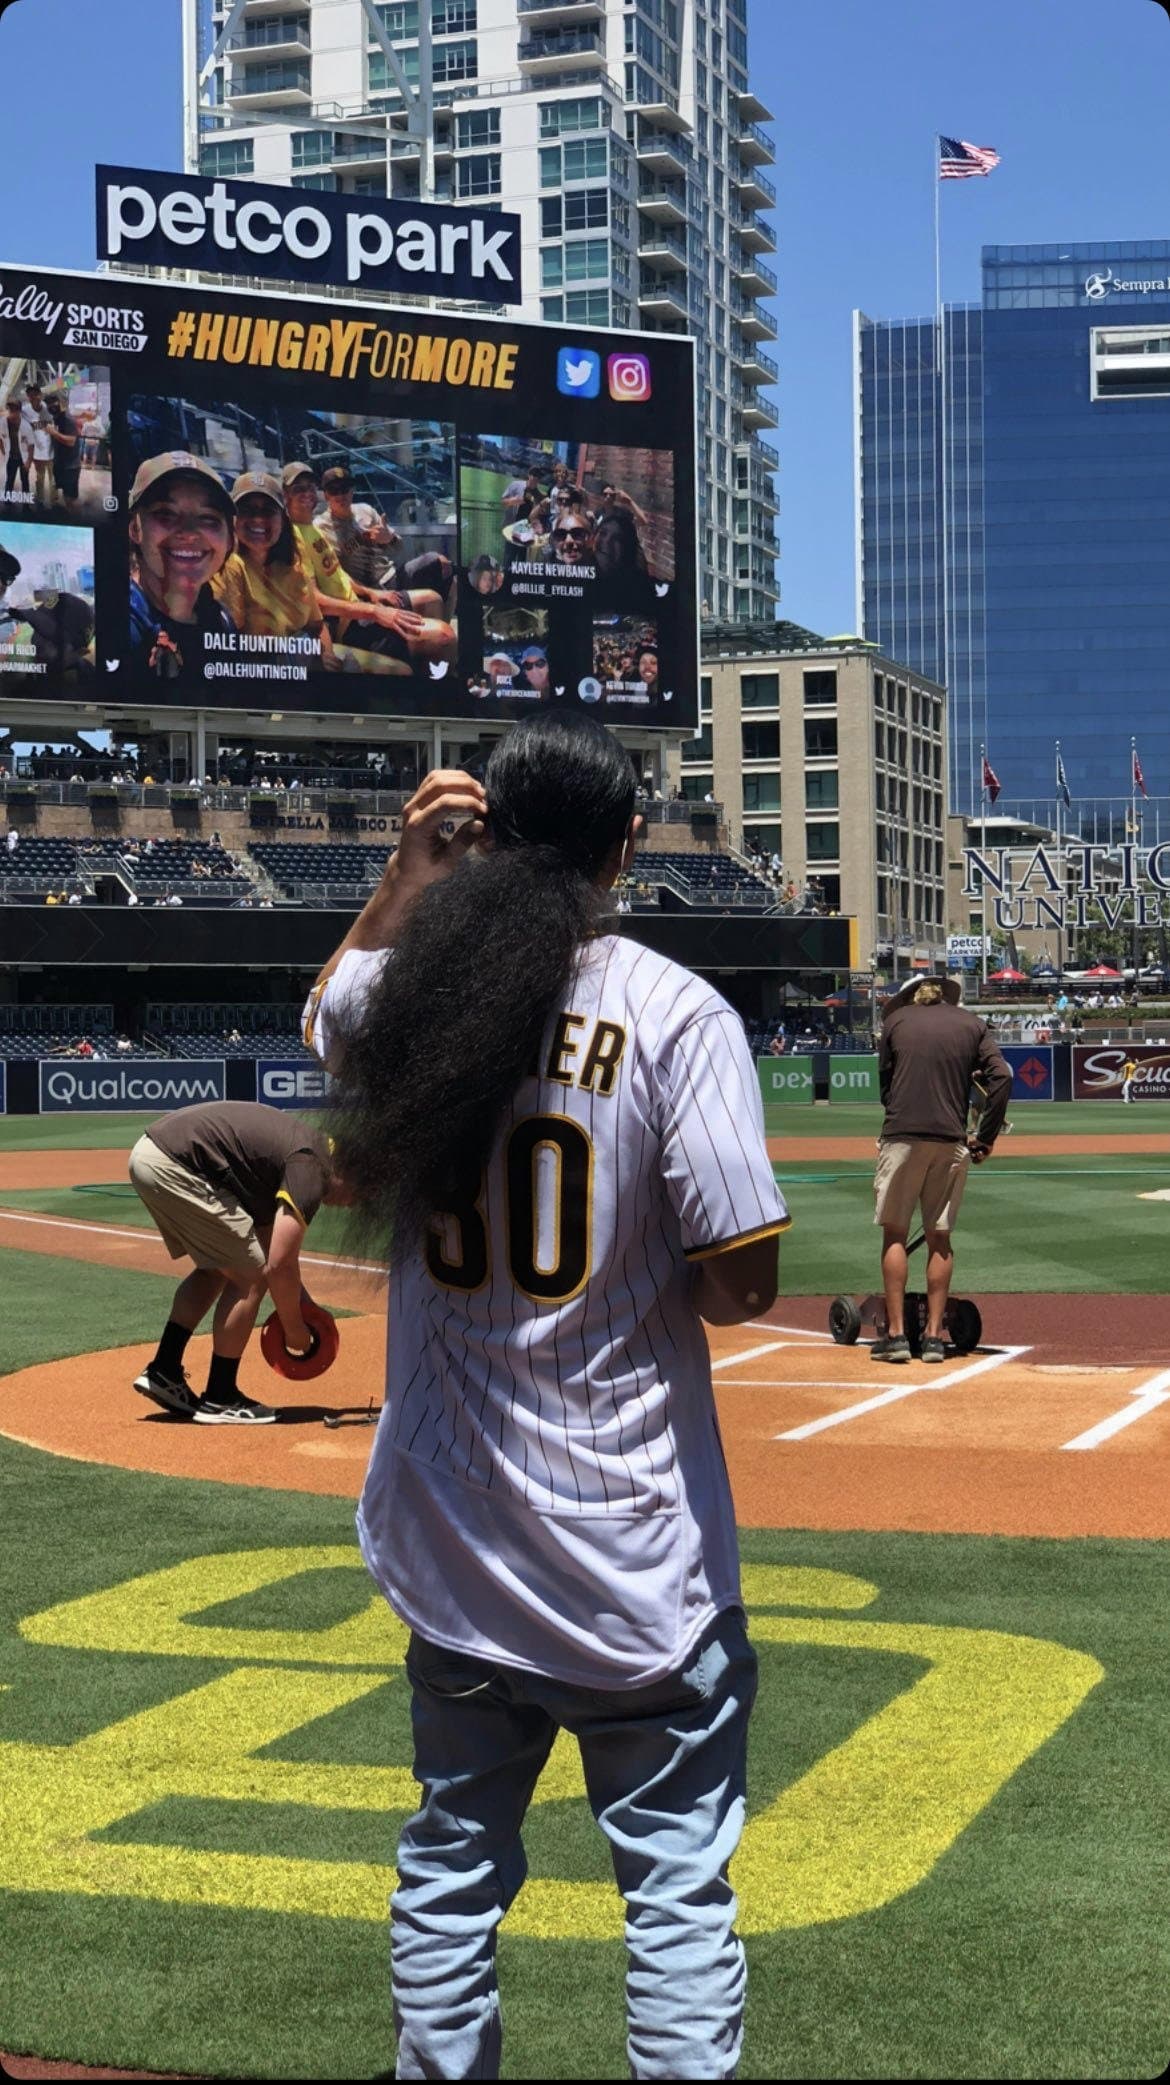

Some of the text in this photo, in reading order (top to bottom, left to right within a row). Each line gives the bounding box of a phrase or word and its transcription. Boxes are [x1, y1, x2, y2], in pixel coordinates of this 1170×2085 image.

[107, 183, 514, 281] petco park
[1113, 278, 1165, 294] Sempra
[0, 284, 145, 335] ally SPORTS
[72, 330, 139, 350] SAN DIEGO
[168, 310, 520, 390] #HUNGRYFORMORE
[511, 561, 596, 579] KAYLEE NEWBANKS
[204, 632, 321, 655] DALE HUNTINGTON
[204, 662, 307, 680] @DALEHUNTINGTON
[993, 892, 1170, 931] UNIVE
[528, 1011, 626, 1096] ER
[48, 1071, 219, 1104] Qualcomm
[1132, 1085, 1166, 1094] CASINO
[425, 1112, 595, 1304] 30
